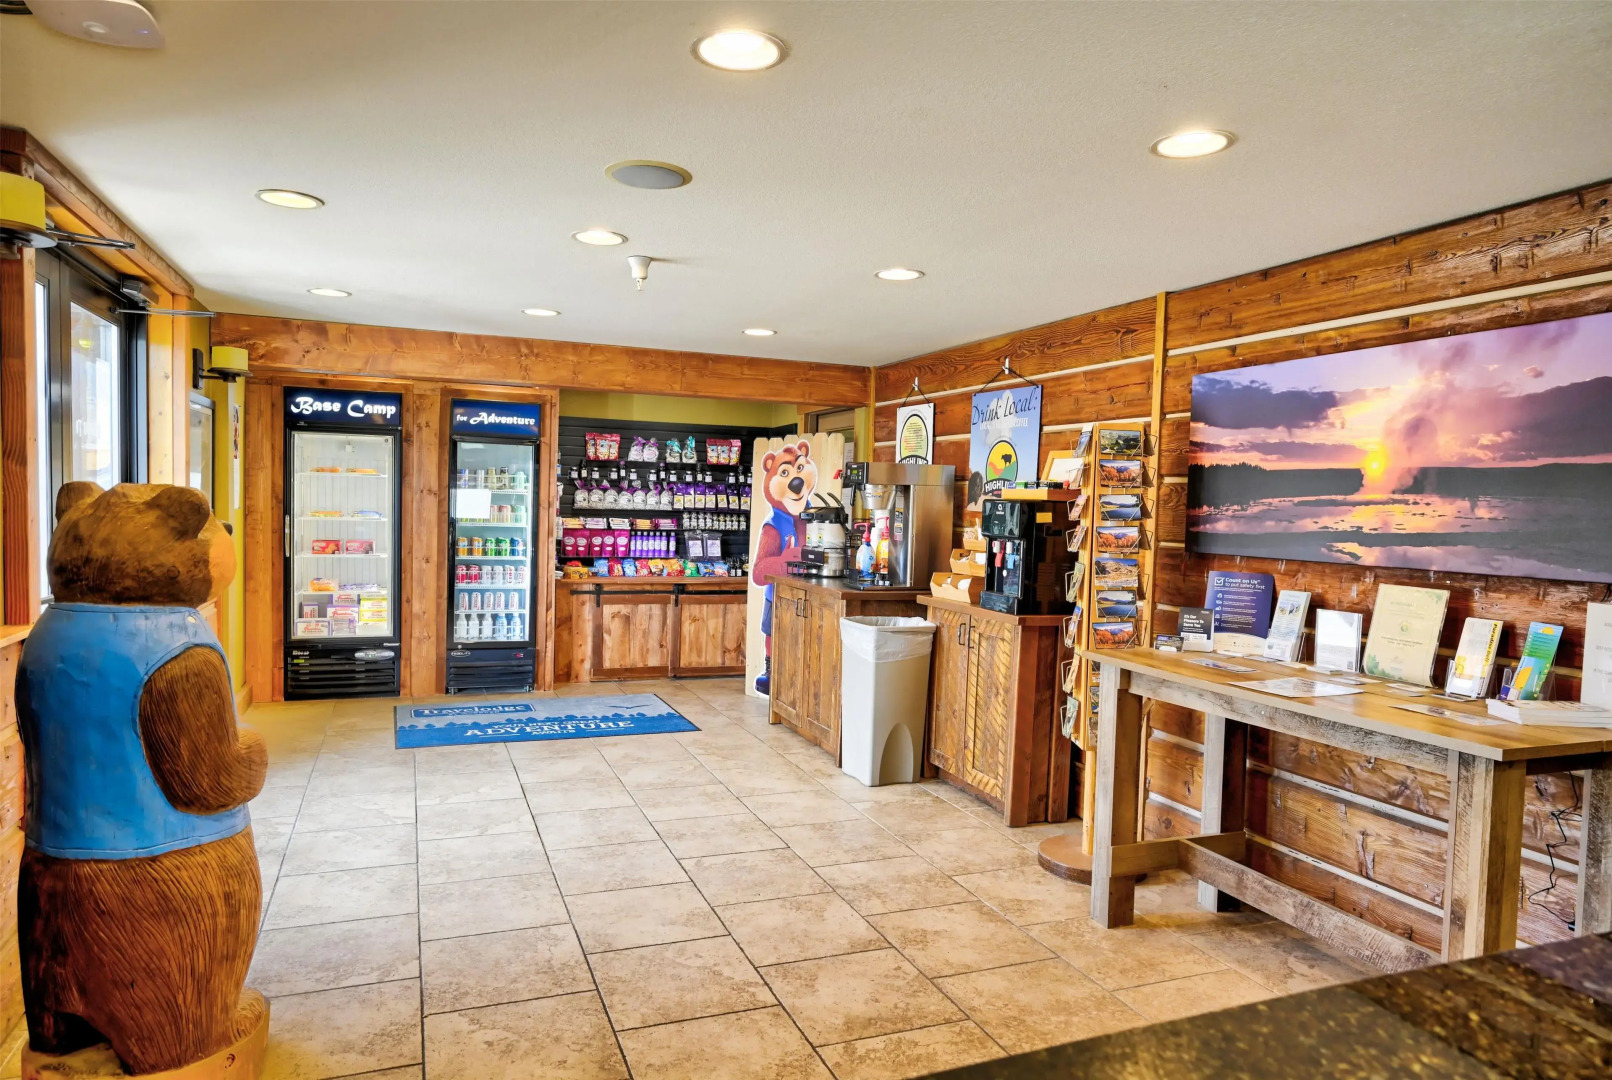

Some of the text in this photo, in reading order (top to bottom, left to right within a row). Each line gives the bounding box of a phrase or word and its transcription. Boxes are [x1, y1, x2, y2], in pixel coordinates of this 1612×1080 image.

[290, 396, 397, 419] Base Camp
[971, 398, 1001, 425] Drink
[456, 412, 536, 426] for Adventure
[419, 704, 526, 715] Travelodge
[463, 720, 635, 737] ADVENTURE
